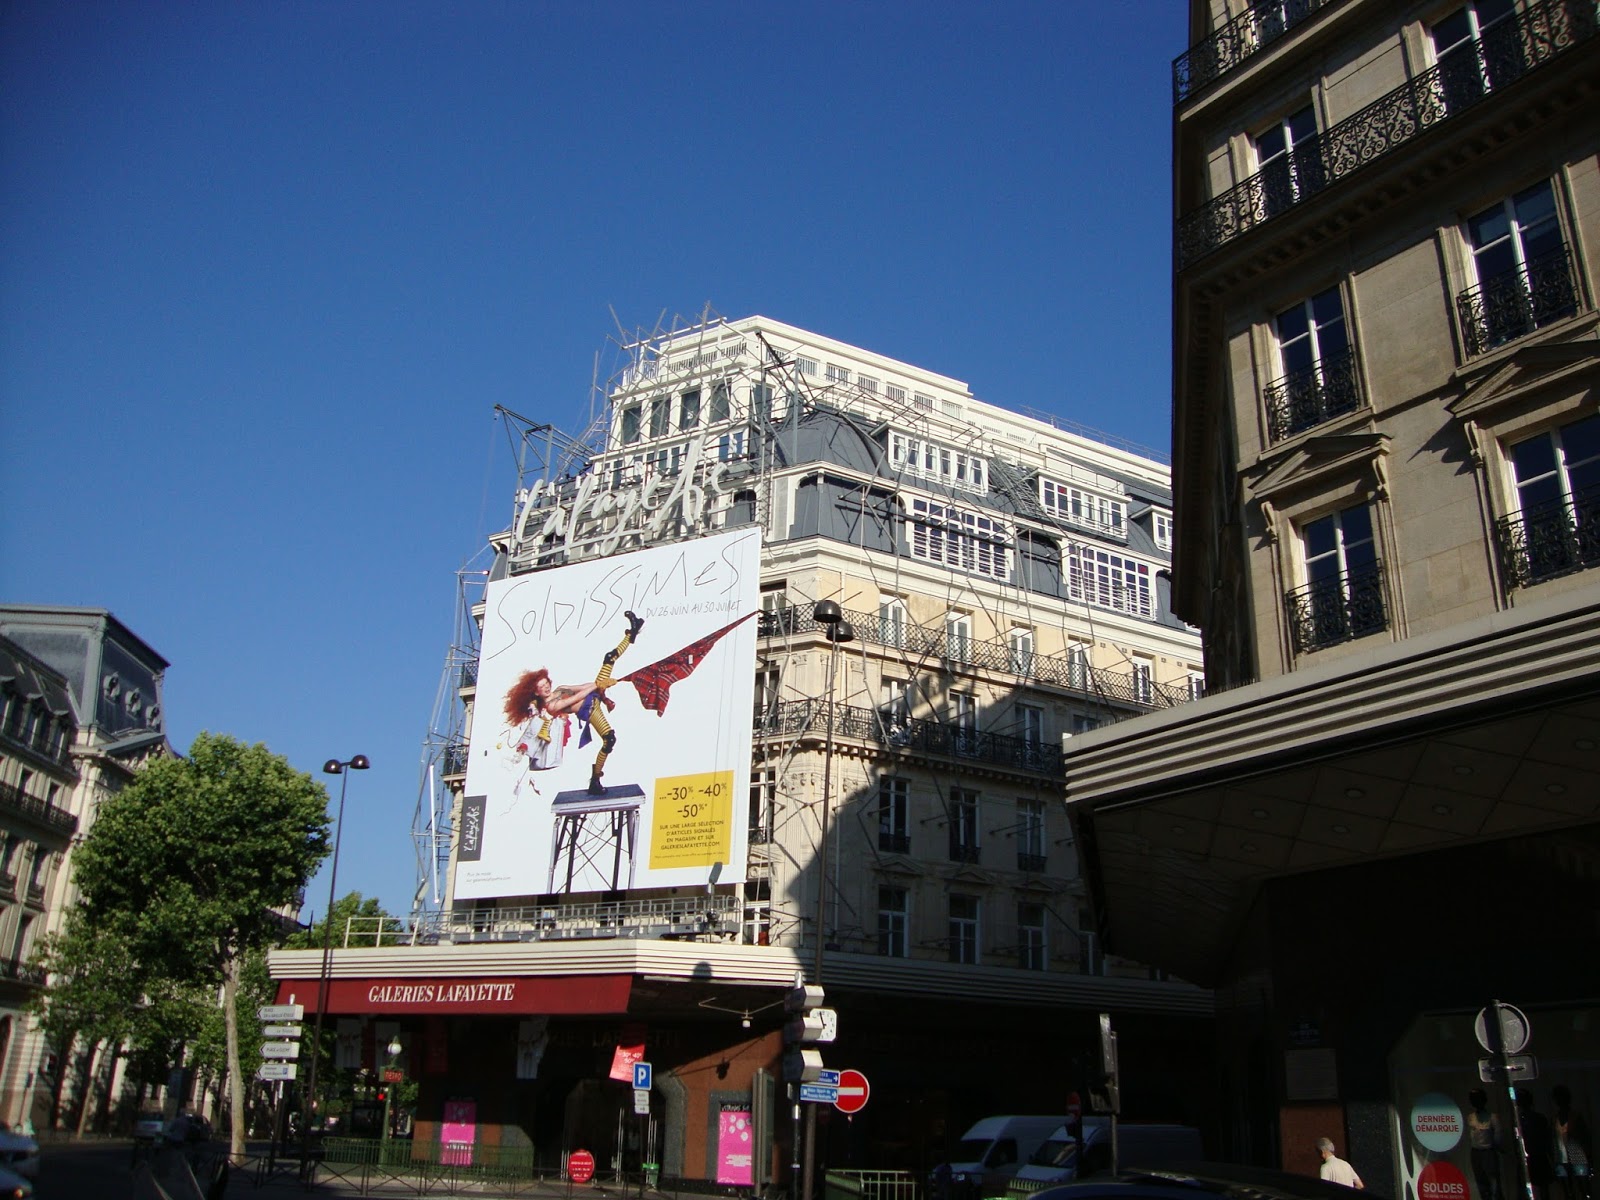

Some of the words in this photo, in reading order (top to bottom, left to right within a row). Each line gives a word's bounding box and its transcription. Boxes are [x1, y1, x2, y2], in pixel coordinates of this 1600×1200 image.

[658, 607, 668, 616] 26
[691, 603, 702, 614] AU
[703, 602, 715, 613] 30
[368, 985, 434, 1003] GALERIES
[436, 983, 515, 1002] LAFAYETTE
[638, 1067, 647, 1085] P
[1417, 1114, 1456, 1123] DERNIÈRE
[1415, 1124, 1460, 1132] DÉMARQUE
[1423, 1182, 1464, 1194] SOLDES
